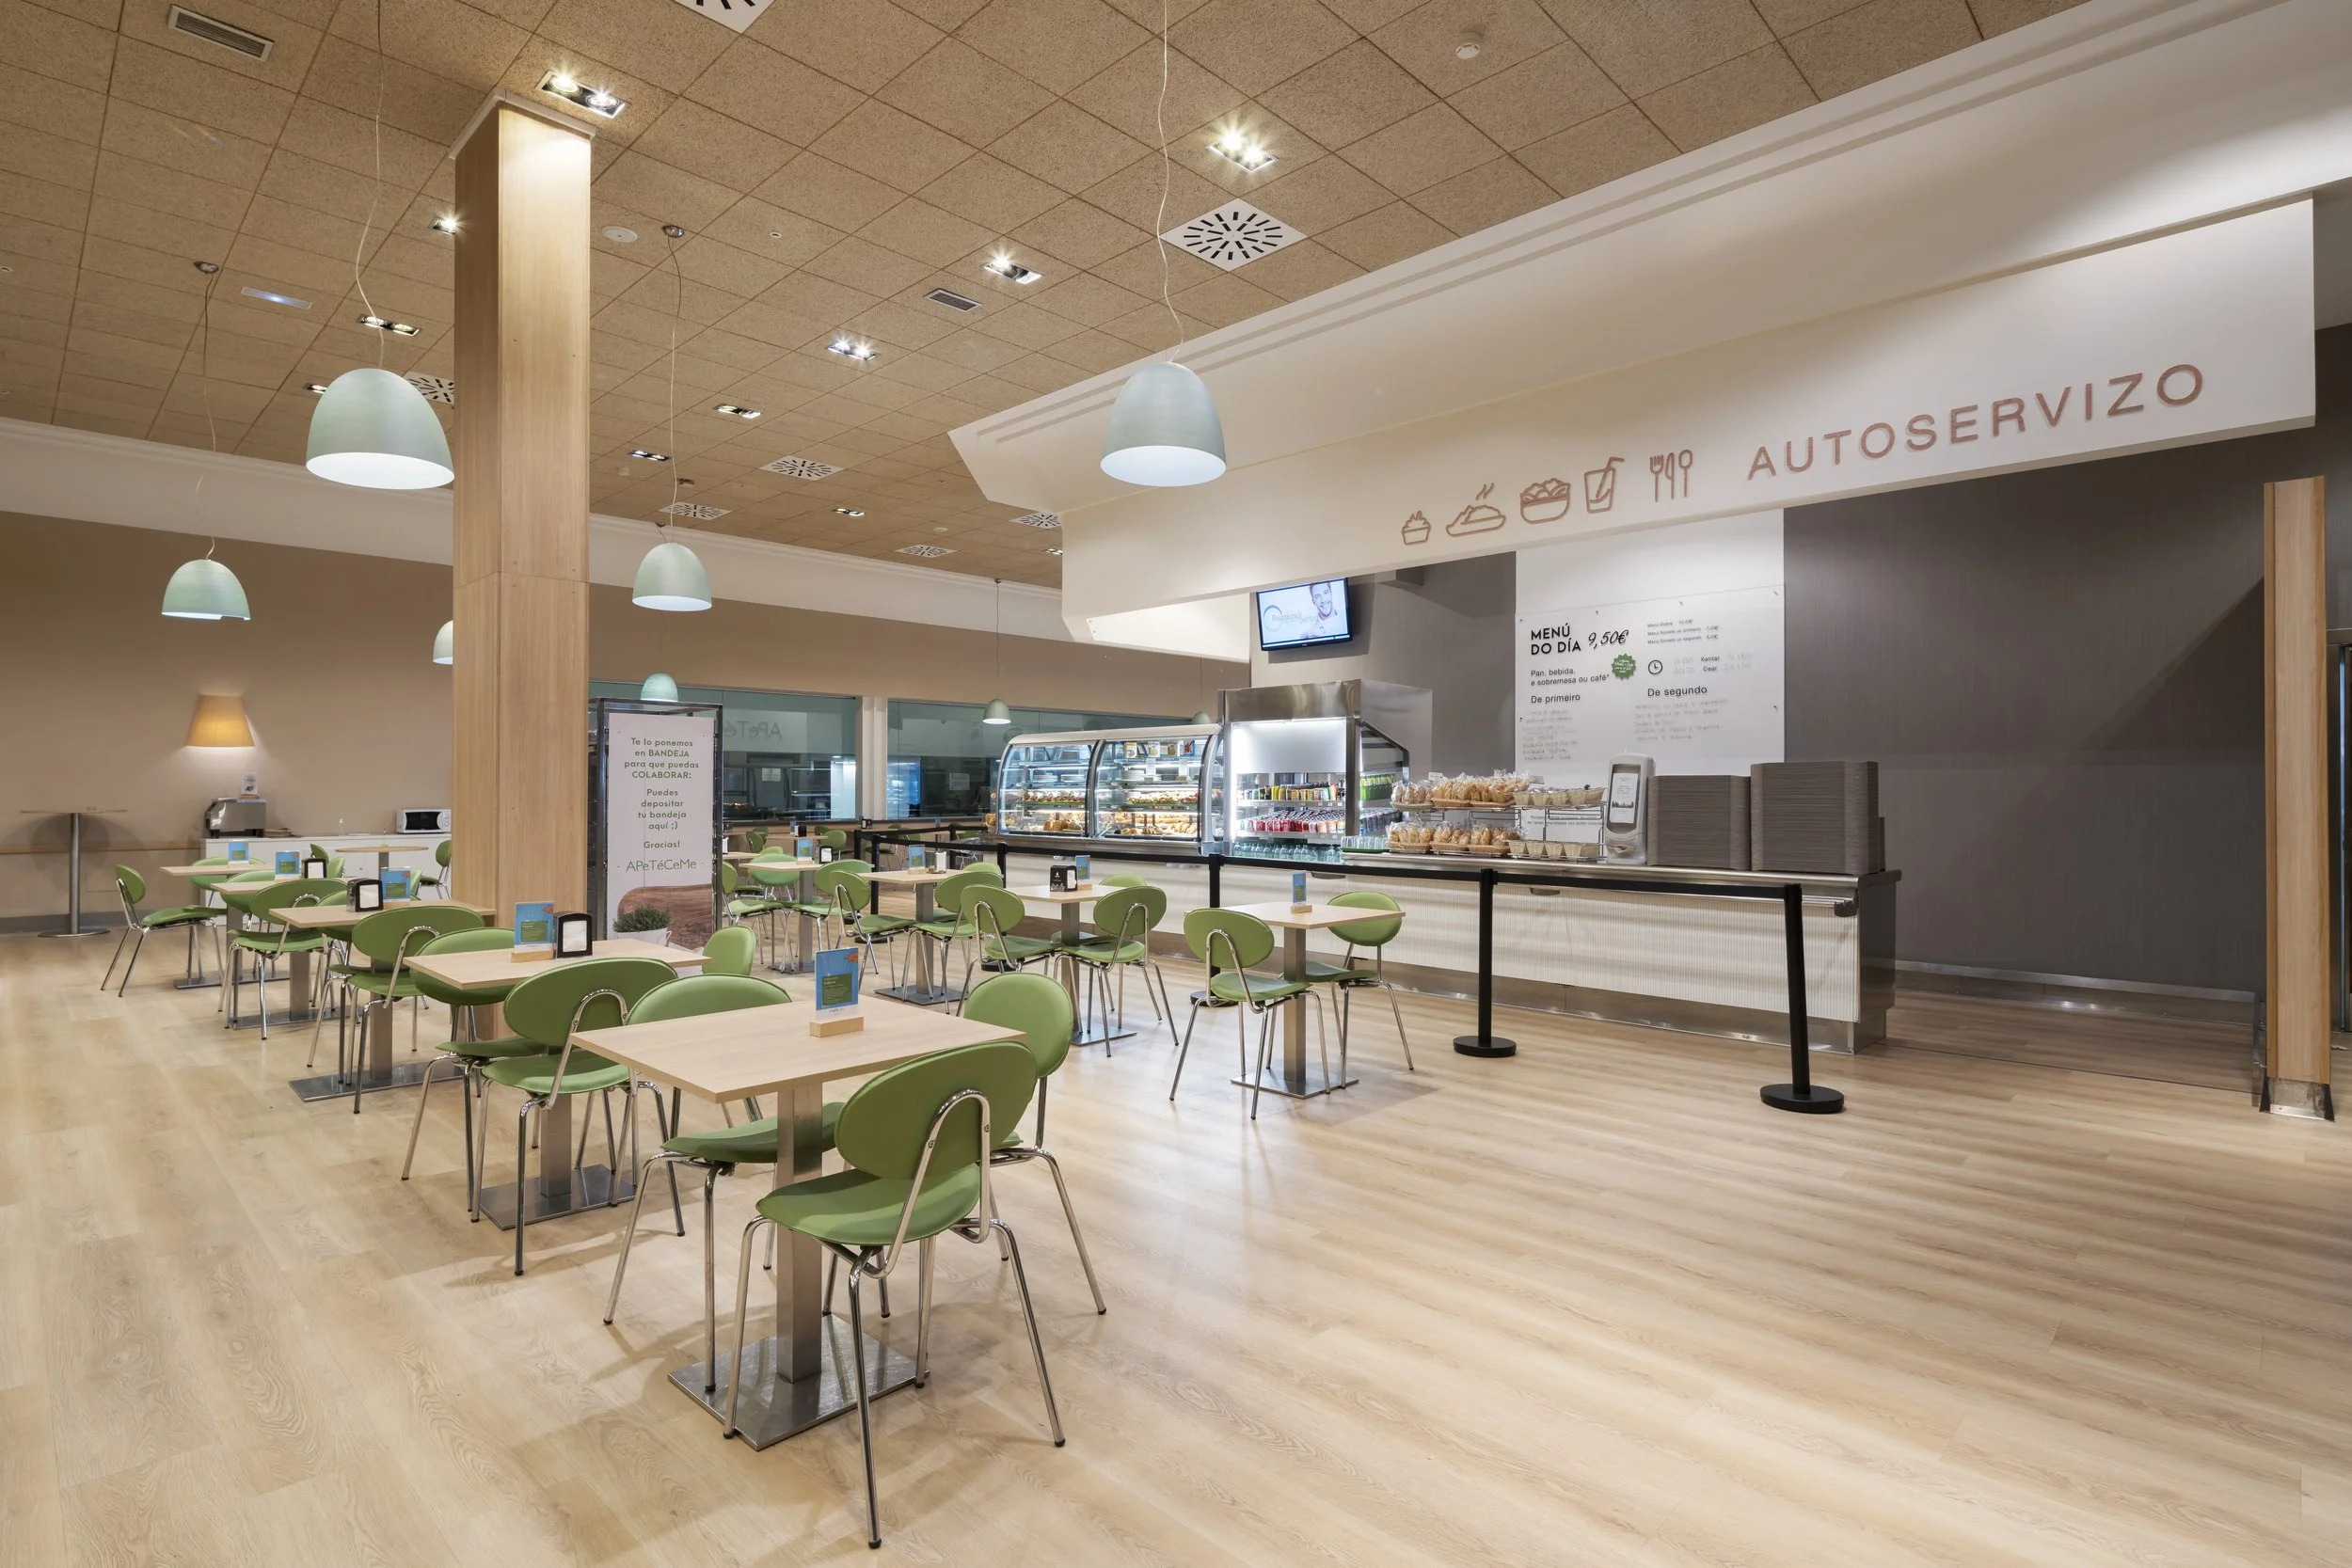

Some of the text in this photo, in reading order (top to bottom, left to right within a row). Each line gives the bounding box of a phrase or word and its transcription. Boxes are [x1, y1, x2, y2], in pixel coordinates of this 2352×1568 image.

[1747, 363, 2203, 481] AUTOSERVIZO
[1531, 623, 1570, 641] MENÚ
[1588, 629, 1629, 650] 9,50€
[1531, 638, 1581, 656] DO DÍA
[1531, 667, 1576, 677] Pan, bebida,
[1537, 676, 1576, 686] sobremesa
[1647, 685, 1708, 697] De segundo
[1531, 692, 1581, 705] De primeiro
[648, 749, 690, 757] BANDEJA
[668, 761, 699, 769] puedas
[631, 770, 691, 779] COLABORAR:
[646, 788, 678, 797] Puedes
[641, 800, 684, 808] depositar
[649, 811, 687, 819] bandeja
[648, 822, 668, 831] aquí
[643, 840, 680, 848] Gracias!
[626, 858, 697, 872] APeTéCeMe
